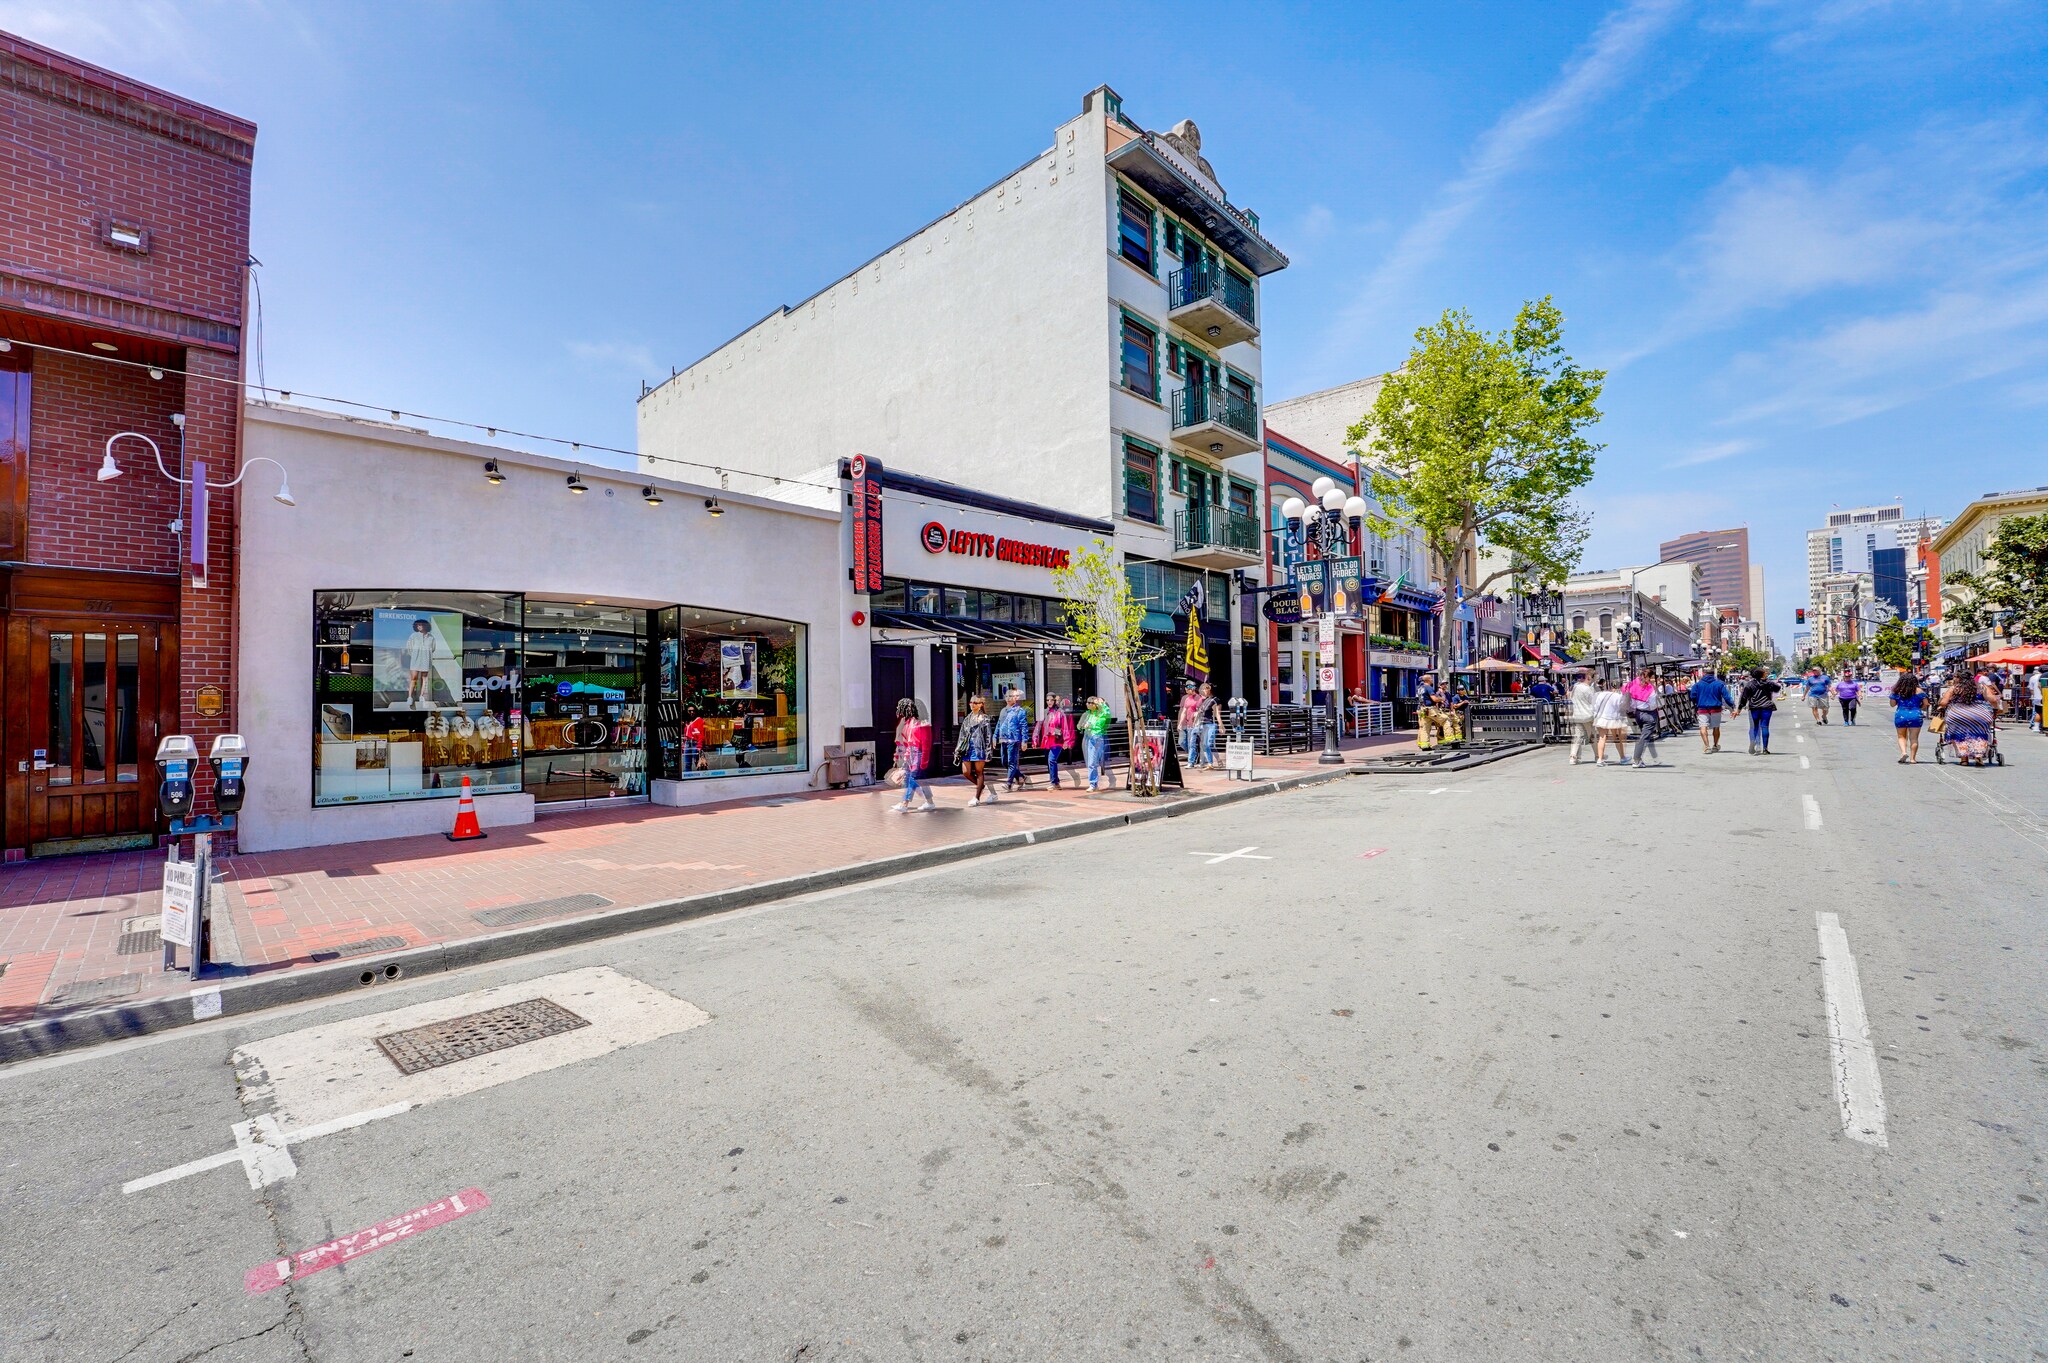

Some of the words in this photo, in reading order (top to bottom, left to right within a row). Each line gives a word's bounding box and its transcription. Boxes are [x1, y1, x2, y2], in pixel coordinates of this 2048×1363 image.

[853, 481, 864, 518] LEFTY'S
[867, 480, 880, 519] LEFTY'S
[949, 529, 995, 557] LEFTY'S
[997, 537, 1070, 569] CHEESESTEAKS
[854, 521, 866, 590] CHEESESTEAKS
[868, 520, 882, 590] CHEESESTEAKS
[1296, 565, 1312, 574] LET'S
[1313, 564, 1322, 572] GO
[1331, 561, 1348, 570] LET'S
[1349, 560, 1358, 568] GO
[1297, 572, 1322, 581] PADRES!
[1332, 568, 1358, 578] PADRES!
[1273, 600, 1299, 608] DOUB
[378, 612, 417, 620] BIRKENSTOCK
[1275, 607, 1299, 615] BLAC
[1391, 655, 1400, 663] THE
[1400, 655, 1412, 664] FIELD
[605, 691, 624, 699] OPEN
[224, 788, 236, 796] 508
[297, 1227, 379, 1264] LANE
